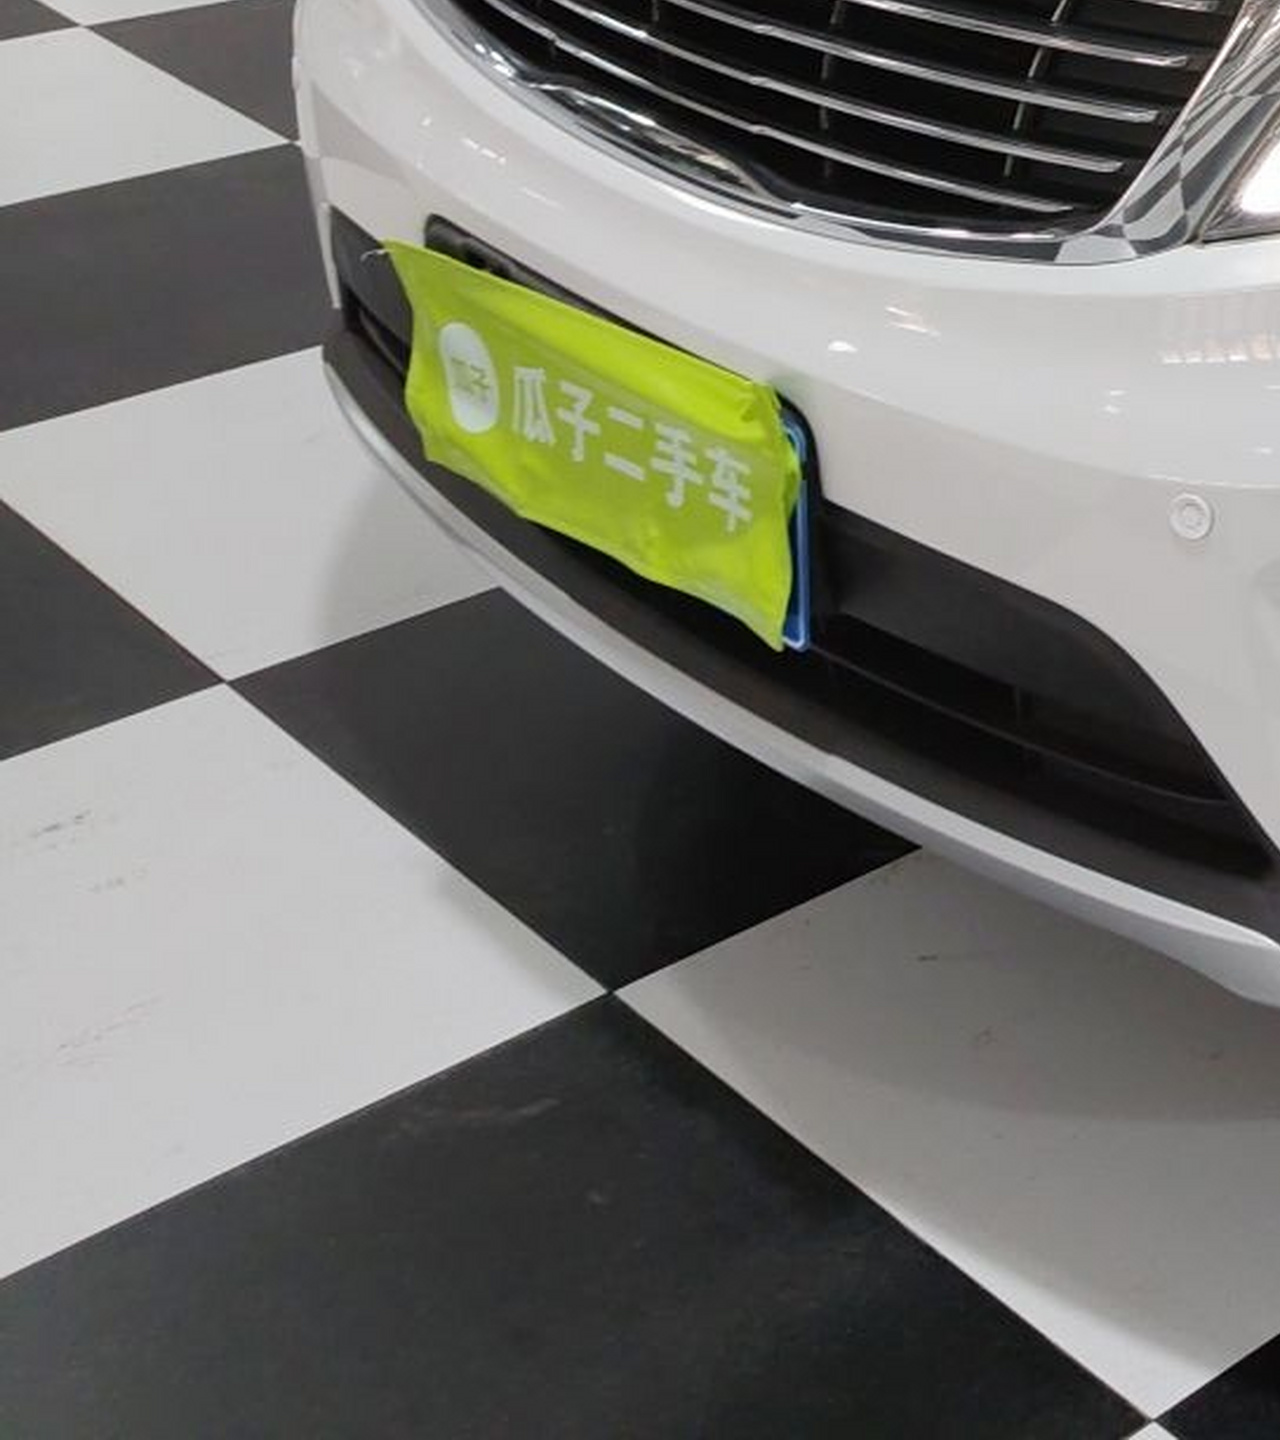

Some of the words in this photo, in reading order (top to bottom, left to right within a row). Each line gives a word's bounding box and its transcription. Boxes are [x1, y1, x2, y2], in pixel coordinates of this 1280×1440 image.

[511, 364, 754, 534] 瓜子二手车
